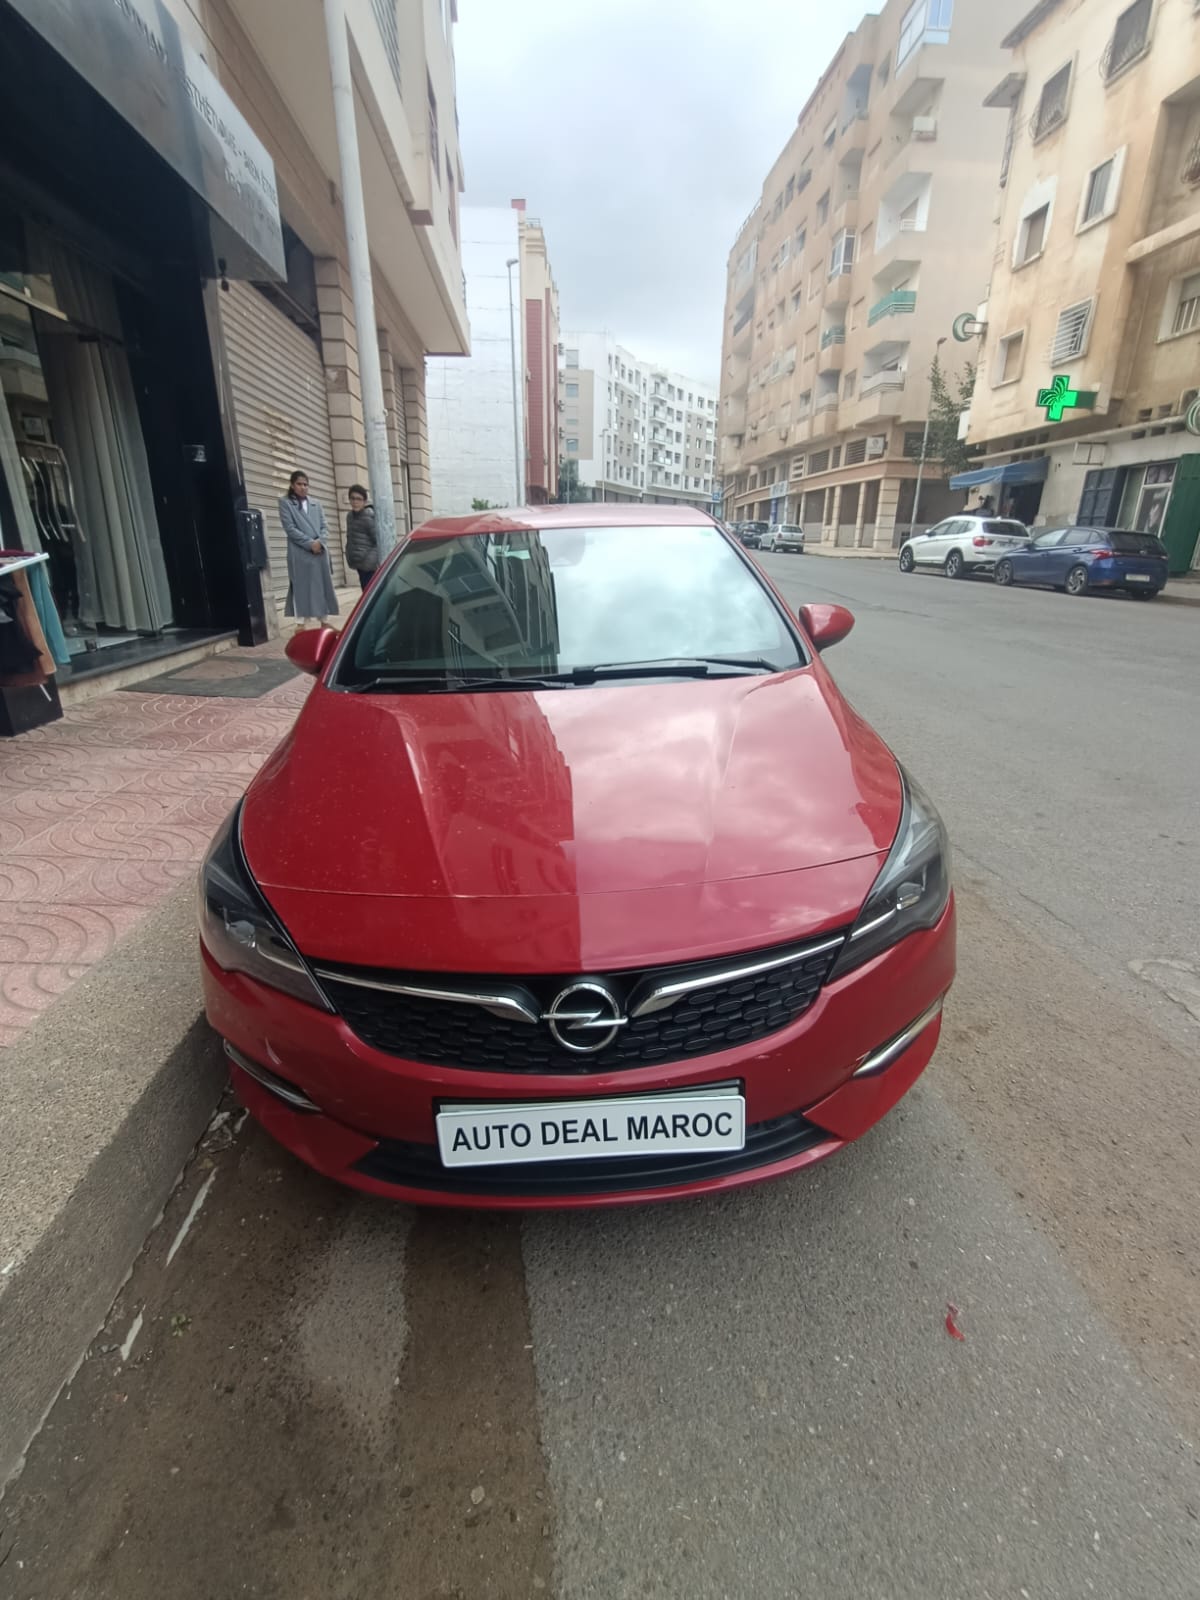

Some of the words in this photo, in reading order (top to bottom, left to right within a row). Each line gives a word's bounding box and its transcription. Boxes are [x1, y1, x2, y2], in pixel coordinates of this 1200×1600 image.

[451, 1122, 532, 1152] AUTO
[540, 1118, 618, 1146] DEAL
[626, 1111, 733, 1141] MAROC
